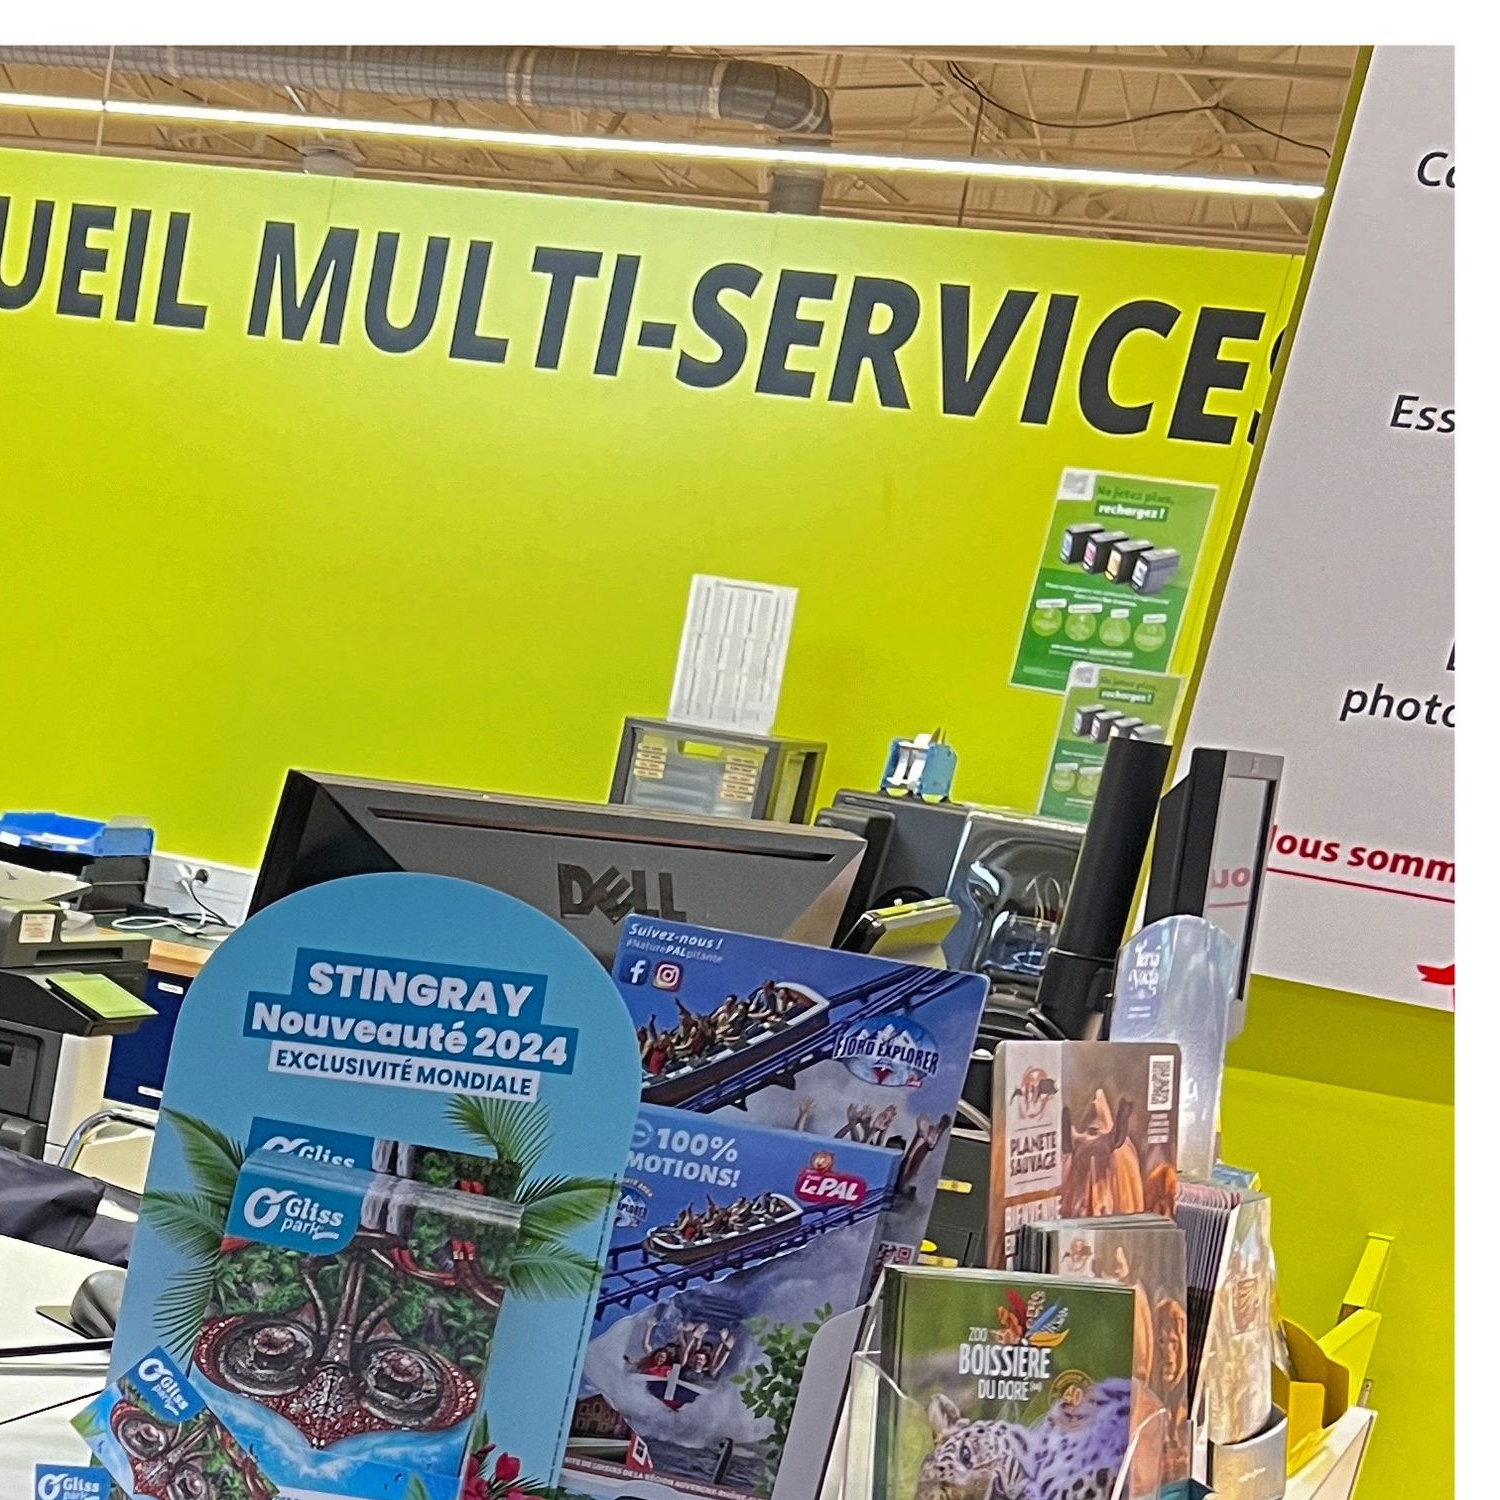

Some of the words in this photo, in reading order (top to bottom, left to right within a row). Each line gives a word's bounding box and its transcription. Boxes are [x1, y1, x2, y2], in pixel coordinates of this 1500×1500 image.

[246, 219, 1288, 446] MULTI-SERVICE
[1098, 504, 1158, 520] rechargez
[1267, 824, 1340, 862] ous
[558, 863, 687, 925] DELL
[629, 923, 713, 949] Suivez-nous
[307, 962, 533, 1018] STINGRAY
[251, 1002, 468, 1054] Nouveauté
[472, 1028, 567, 1066] 2024
[275, 1049, 412, 1082] EXCLUSIVITÉ
[416, 1067, 533, 1097] MONDIALE
[833, 1036, 875, 1059] FJORD
[877, 1040, 940, 1076] EXPLORER
[657, 1128, 739, 1162] 100%
[1010, 1151, 1057, 1177] SAUVAGE
[627, 1150, 740, 1188] MOTIONS!
[280, 1218, 338, 1240] park
[968, 1327, 988, 1342] ZOO
[958, 1340, 1052, 1379] BOISSIÈRE
[978, 1379, 996, 1399] DU
[998, 1376, 1030, 1400] DORÉ
